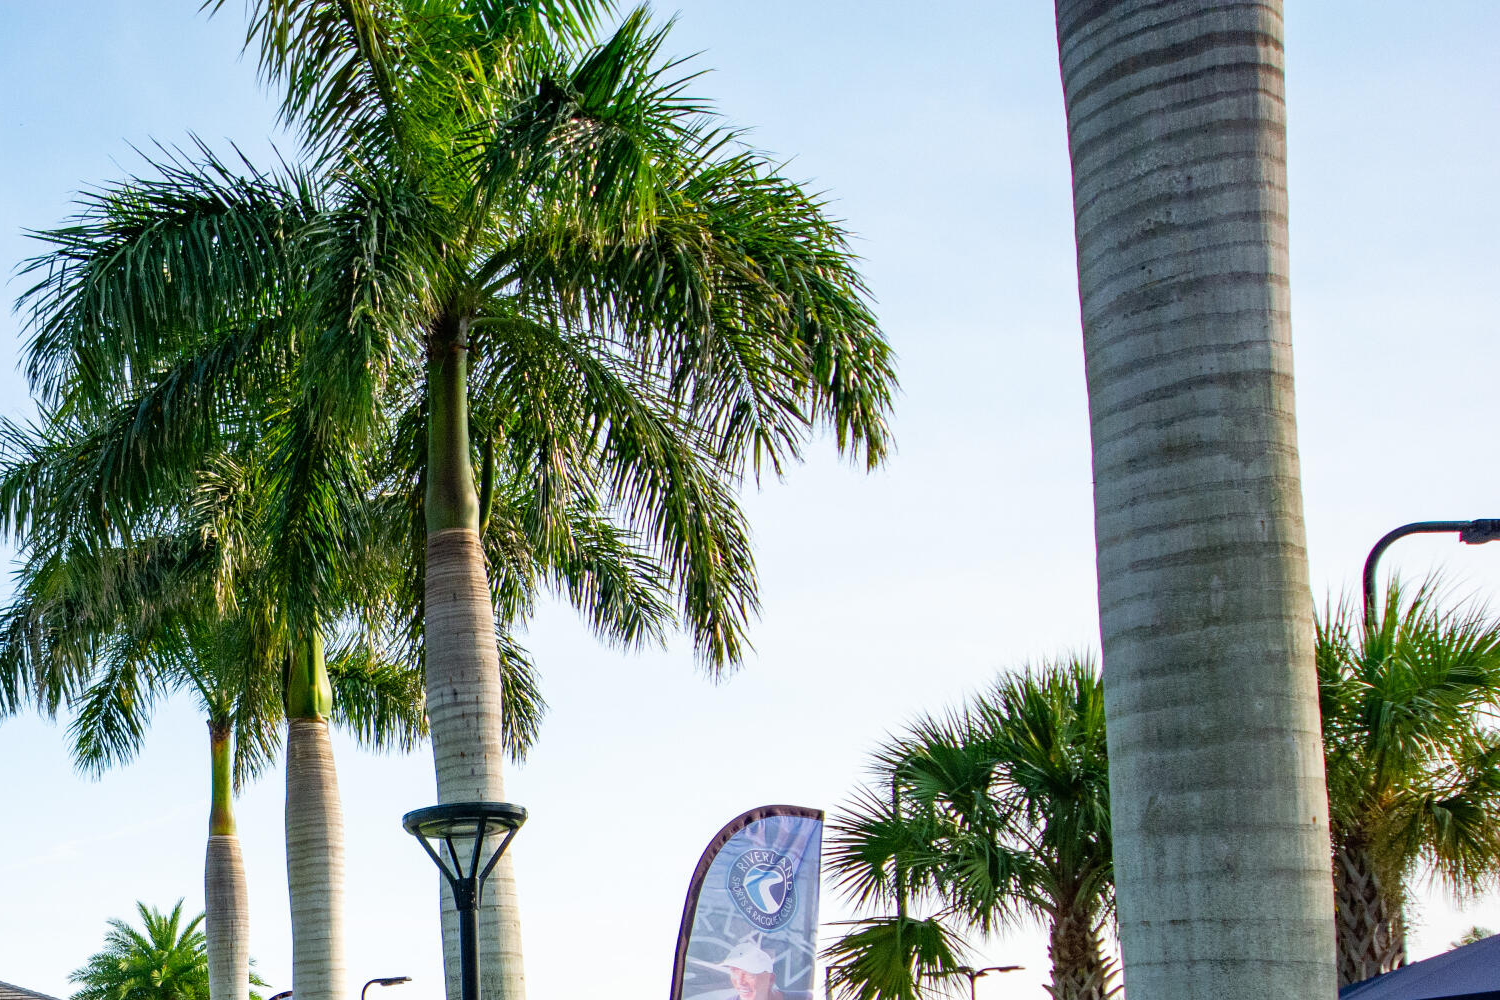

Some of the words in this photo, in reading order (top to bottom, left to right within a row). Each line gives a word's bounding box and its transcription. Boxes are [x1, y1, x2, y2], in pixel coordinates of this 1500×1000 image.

[736, 851, 793, 891] RIVERLAND
[732, 875, 749, 907] SPORTS
[780, 897, 793, 918] CLUB
